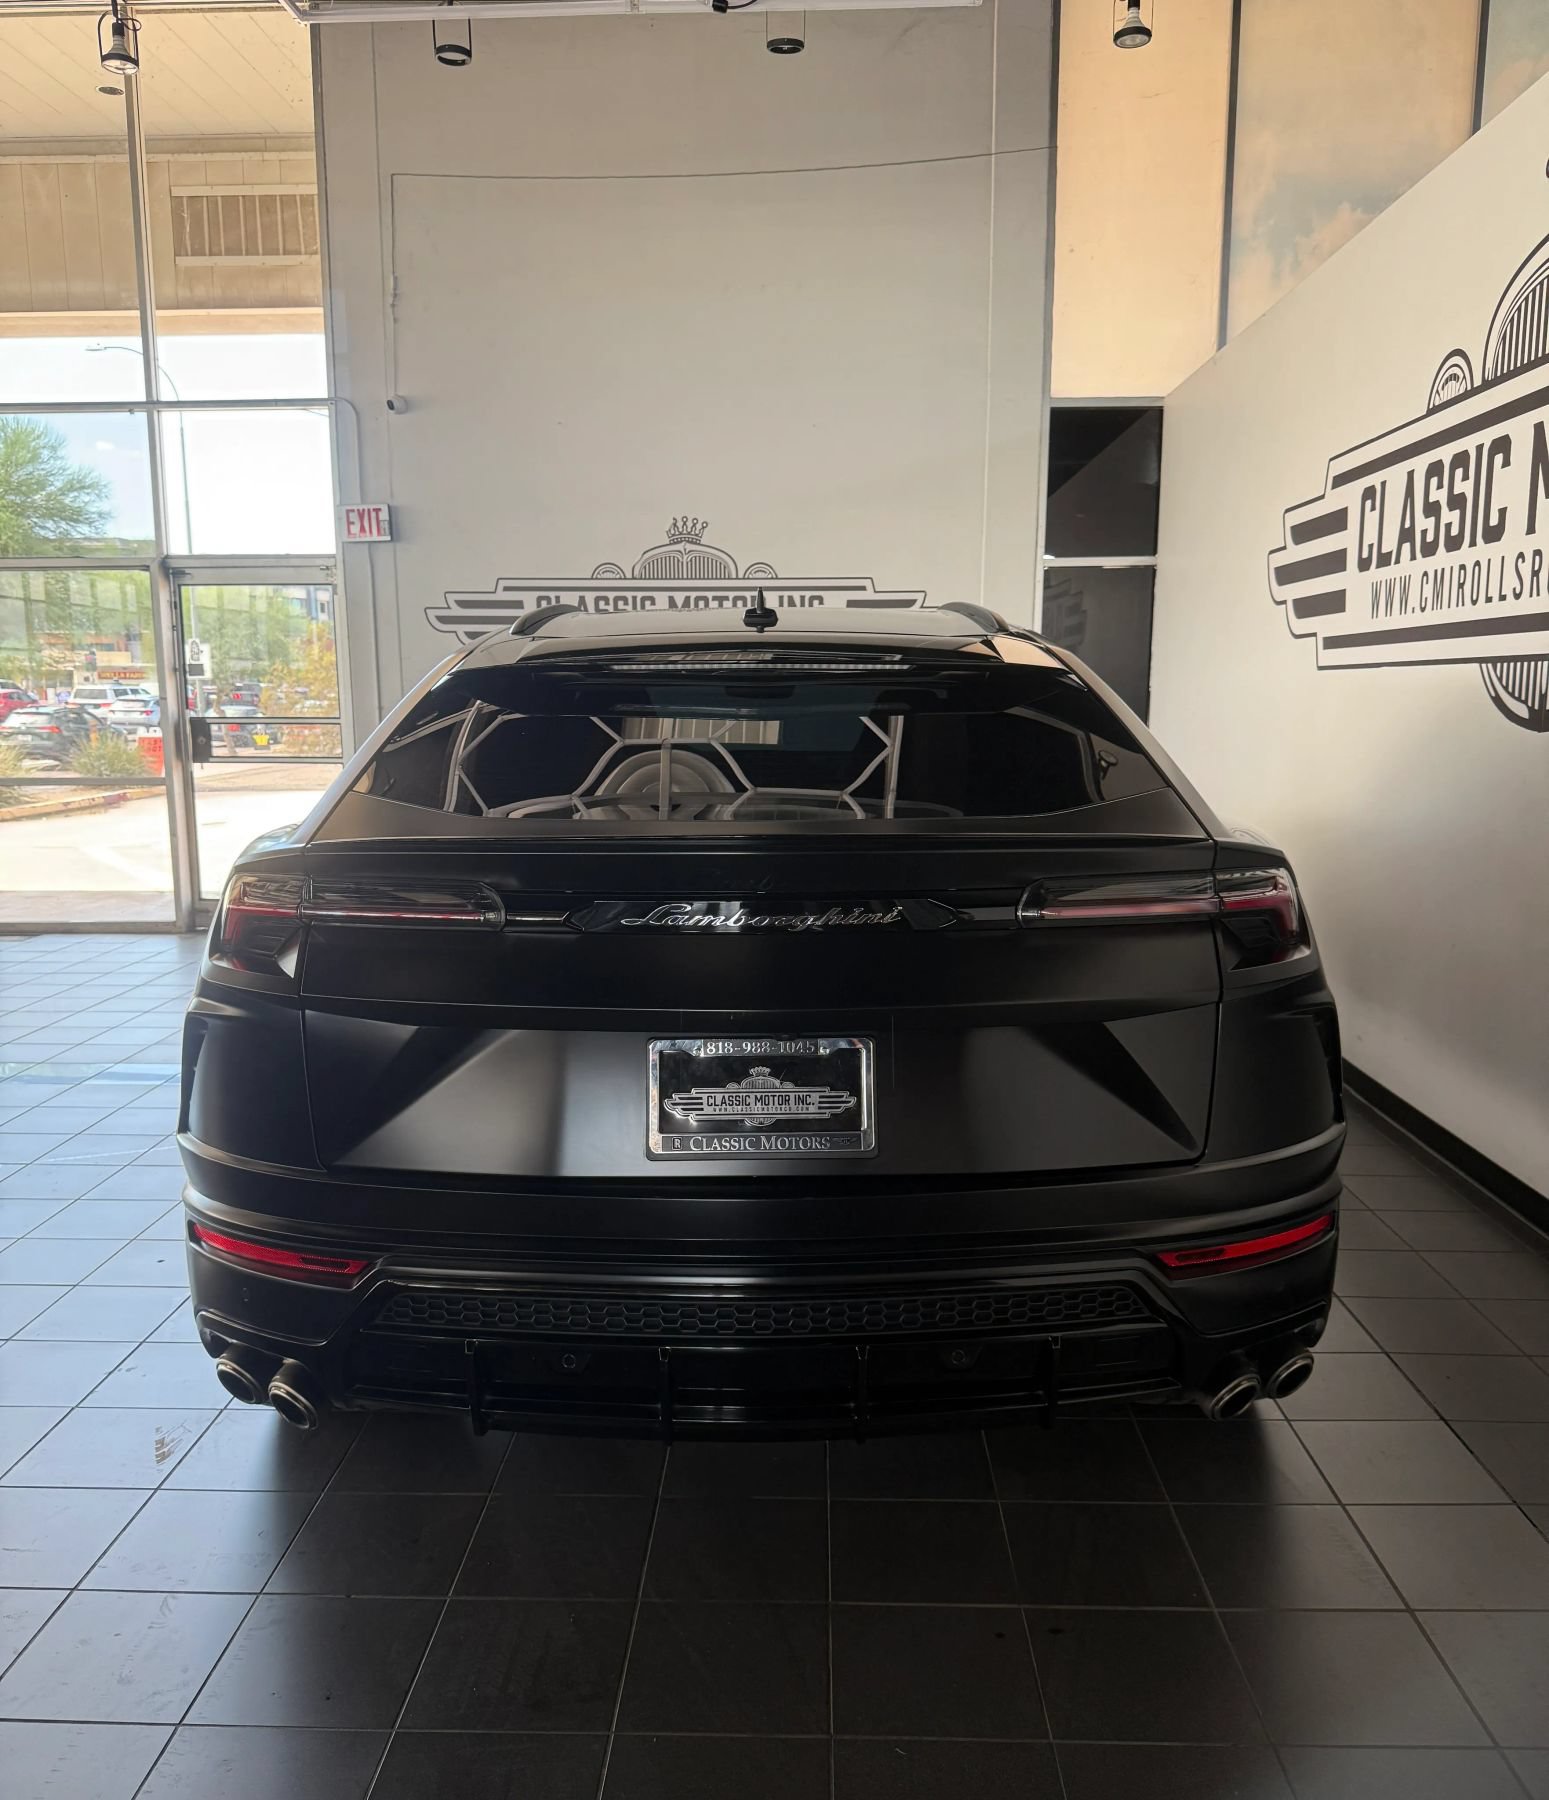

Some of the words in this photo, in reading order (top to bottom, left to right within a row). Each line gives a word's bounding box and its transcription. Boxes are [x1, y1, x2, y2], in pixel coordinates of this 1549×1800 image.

[1357, 433, 1512, 573] CLASSIC
[345, 508, 382, 538] EXIT
[1371, 549, 1549, 619] WWW.CMIROLLSR
[621, 903, 903, 931] Lamborghini
[706, 1041, 814, 1054] 818-988-1045
[706, 1095, 751, 1107] CLASSIC
[754, 1094, 791, 1106] MOTOR
[794, 1094, 815, 1106] INC.
[690, 1136, 756, 1151] CLASSIC
[760, 1135, 830, 1150] MOTORS
